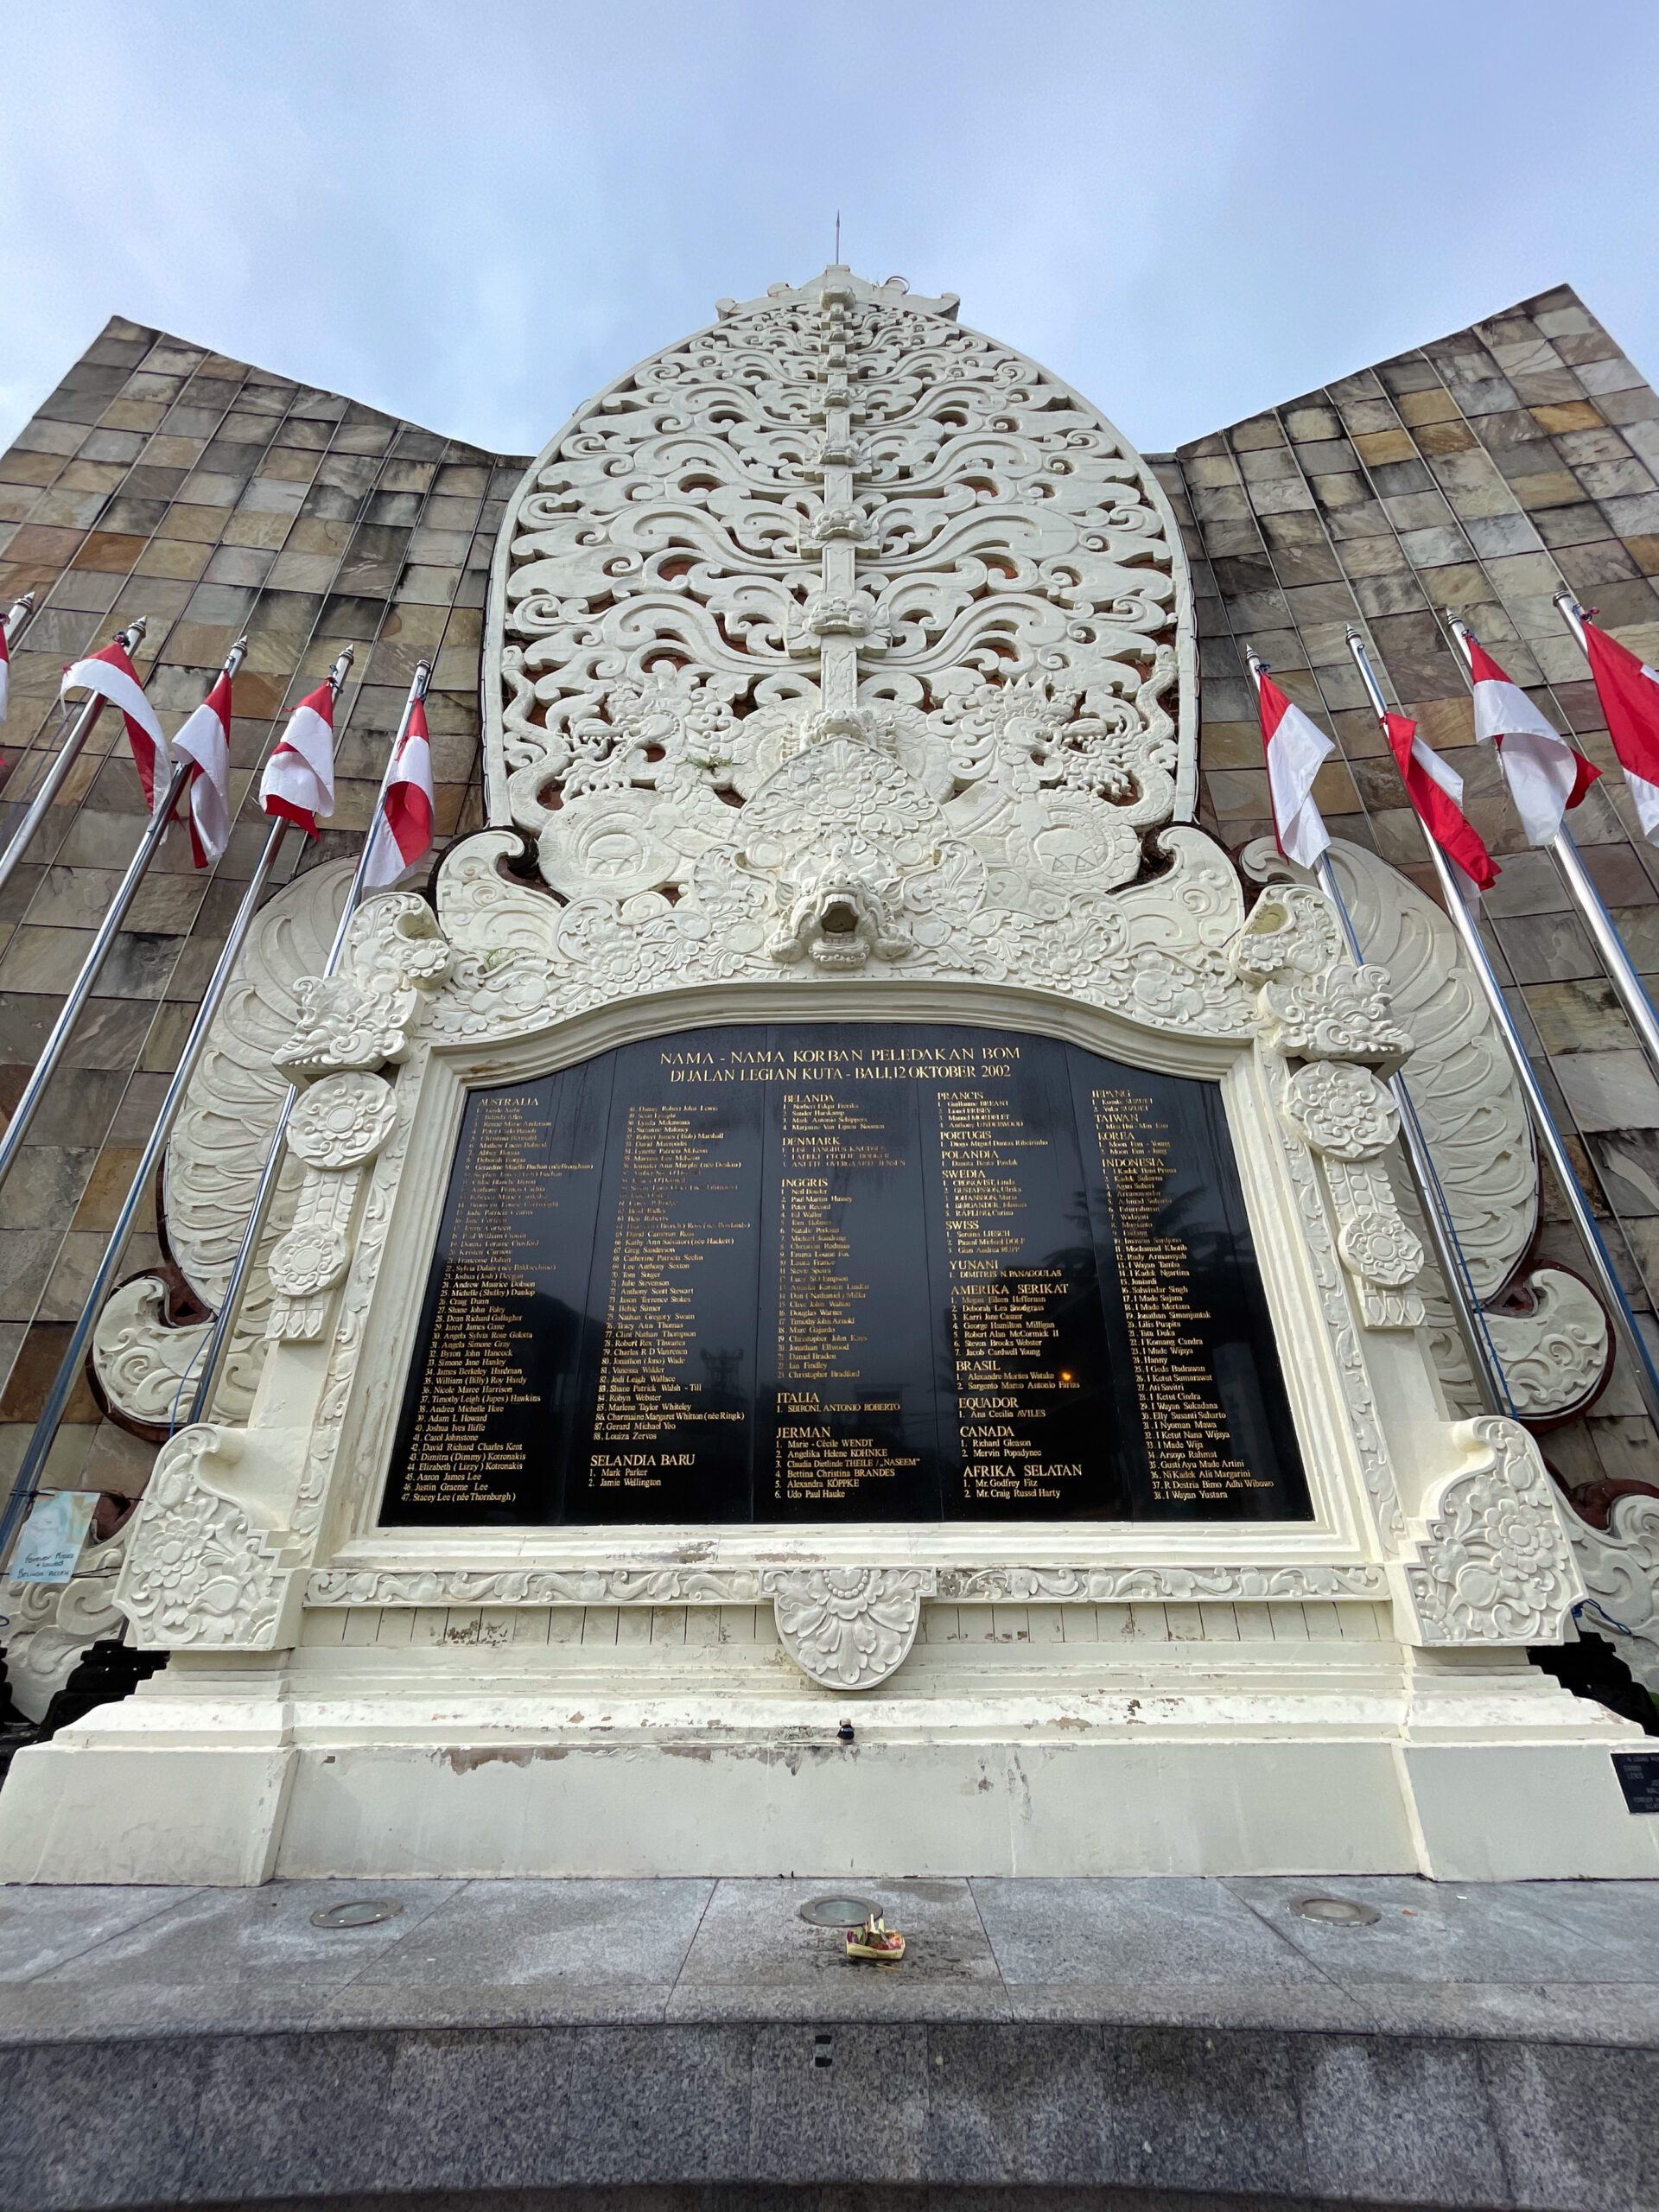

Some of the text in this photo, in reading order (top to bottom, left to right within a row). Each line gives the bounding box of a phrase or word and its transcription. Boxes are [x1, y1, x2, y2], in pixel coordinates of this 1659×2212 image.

[661, 1052, 714, 1065] NAMA
[731, 1051, 785, 1063] NAMA
[794, 1050, 862, 1063] KORBAN
[871, 1048, 974, 1061] PELEDAKAN
[982, 1047, 1020, 1058] BOM
[741, 1069, 797, 1081] LEGIAN
[802, 1068, 842, 1080] KUTA
[908, 1065, 976, 1078] OKTOBER
[982, 1065, 1011, 1077] 2002
[1094, 1114, 1139, 1122] TAIWAN
[940, 1131, 991, 1140] PORTUGIS
[1098, 1132, 1135, 1141] KOREA
[783, 1137, 840, 1146] DENMARK
[1102, 1158, 1164, 1167] INDONESIA
[942, 1170, 985, 1179] SWEDIA
[781, 1179, 828, 1187] INGGRIS
[945, 1220, 979, 1230] SWISS
[950, 1261, 998, 1270] YUNANI
[951, 1284, 1069, 1294] AMERIKA SERIKAT
[1026, 1321, 1055, 1330] Milligan
[1156, 1320, 1180, 1329] Puspita
[1020, 1348, 1040, 1357] Young
[957, 1361, 1001, 1370] BRASIL
[968, 1382, 998, 1391] Sargento
[777, 1393, 820, 1403] ITALIA
[959, 1397, 1019, 1409] EQUADOR
[776, 1427, 830, 1439] JERMAN
[960, 1427, 1014, 1437] CANADA
[787, 1451, 820, 1459] Angelika
[590, 1454, 695, 1466] SELANDIA BARU
[963, 1465, 1083, 1477] AFRIKA SELATAN
[990, 1478, 1020, 1488] Godfrey
[805, 1490, 820, 1498] Paul
[990, 1490, 1010, 1498] Craig
[1039, 1489, 1060, 1498] Harty
[1173, 1491, 1196, 1501] Wayan
